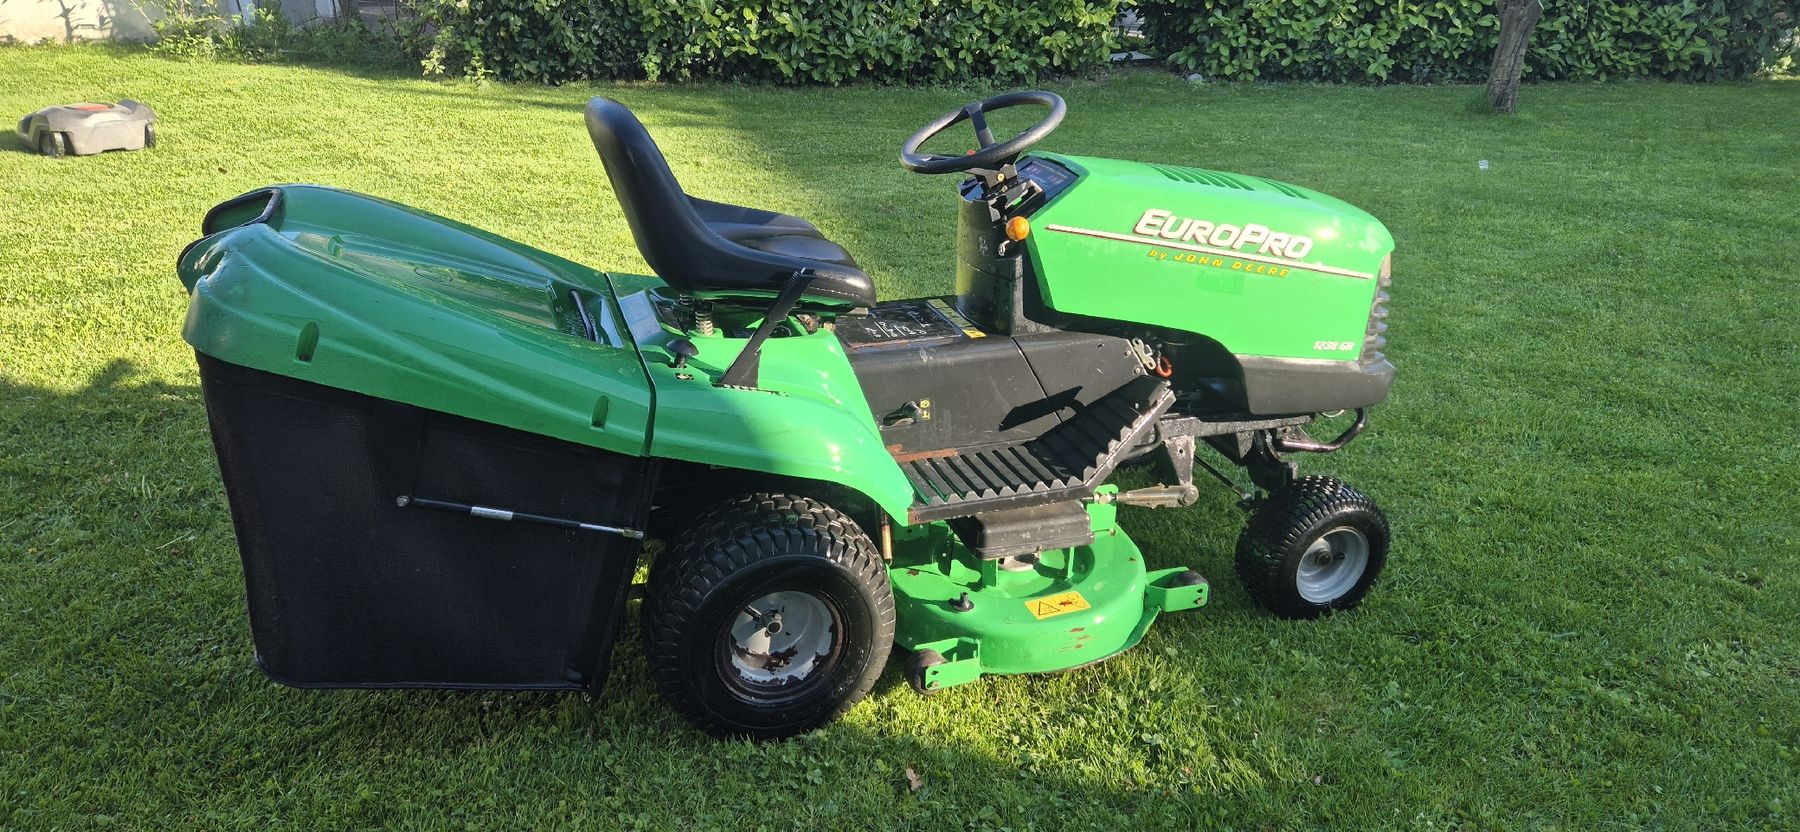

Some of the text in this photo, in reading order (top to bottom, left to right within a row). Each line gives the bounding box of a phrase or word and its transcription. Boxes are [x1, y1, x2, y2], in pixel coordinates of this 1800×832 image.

[1149, 249, 1290, 278] by JOHN DEERE
